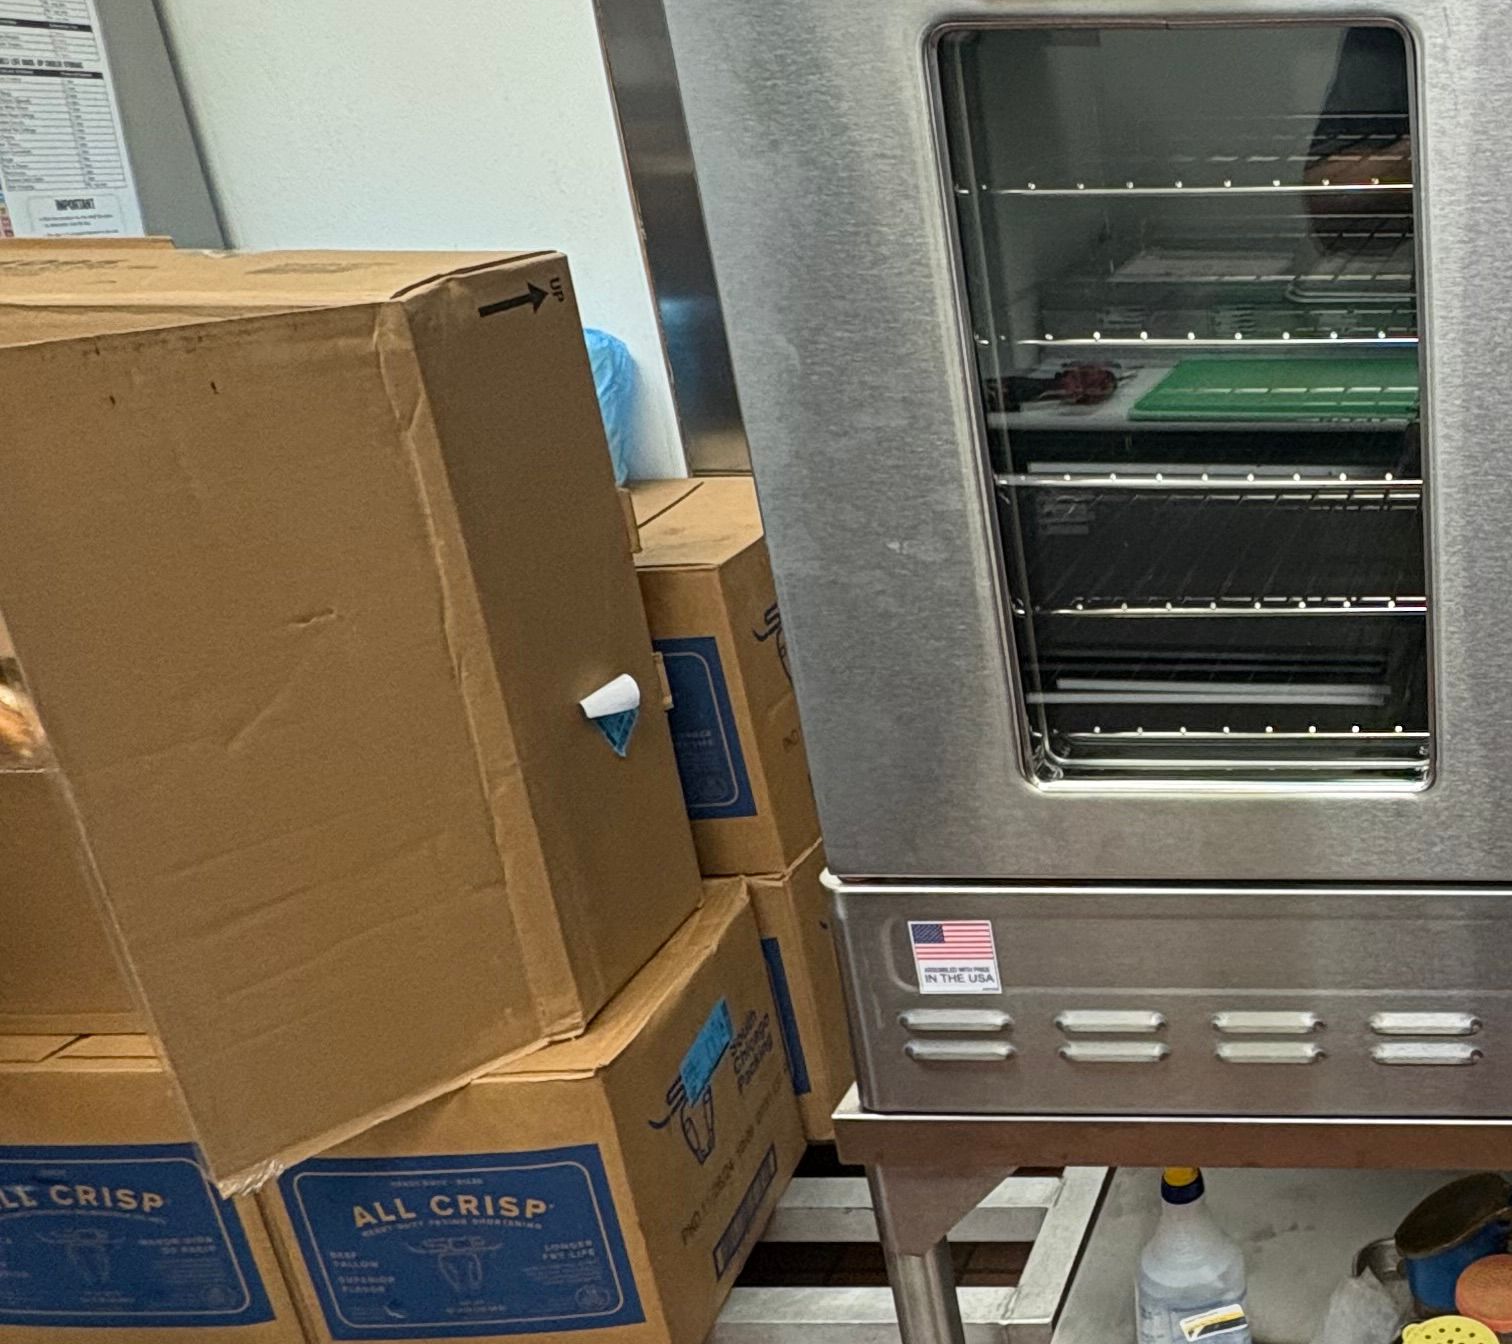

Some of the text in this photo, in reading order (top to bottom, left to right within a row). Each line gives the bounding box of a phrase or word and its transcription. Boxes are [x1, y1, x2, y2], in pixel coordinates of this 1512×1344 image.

[55, 198, 96, 211] IMPORTANT
[549, 277, 565, 302] UP
[925, 974, 996, 984] IN THE USA
[0, 1183, 165, 1213] LL CRISP
[353, 1194, 548, 1228] ALL CRISP
[428, 1218, 467, 1226] FRYING
[471, 1218, 543, 1231] SHORTENING
[544, 1239, 593, 1252] LONGER
[332, 1260, 379, 1268] TALLOW
